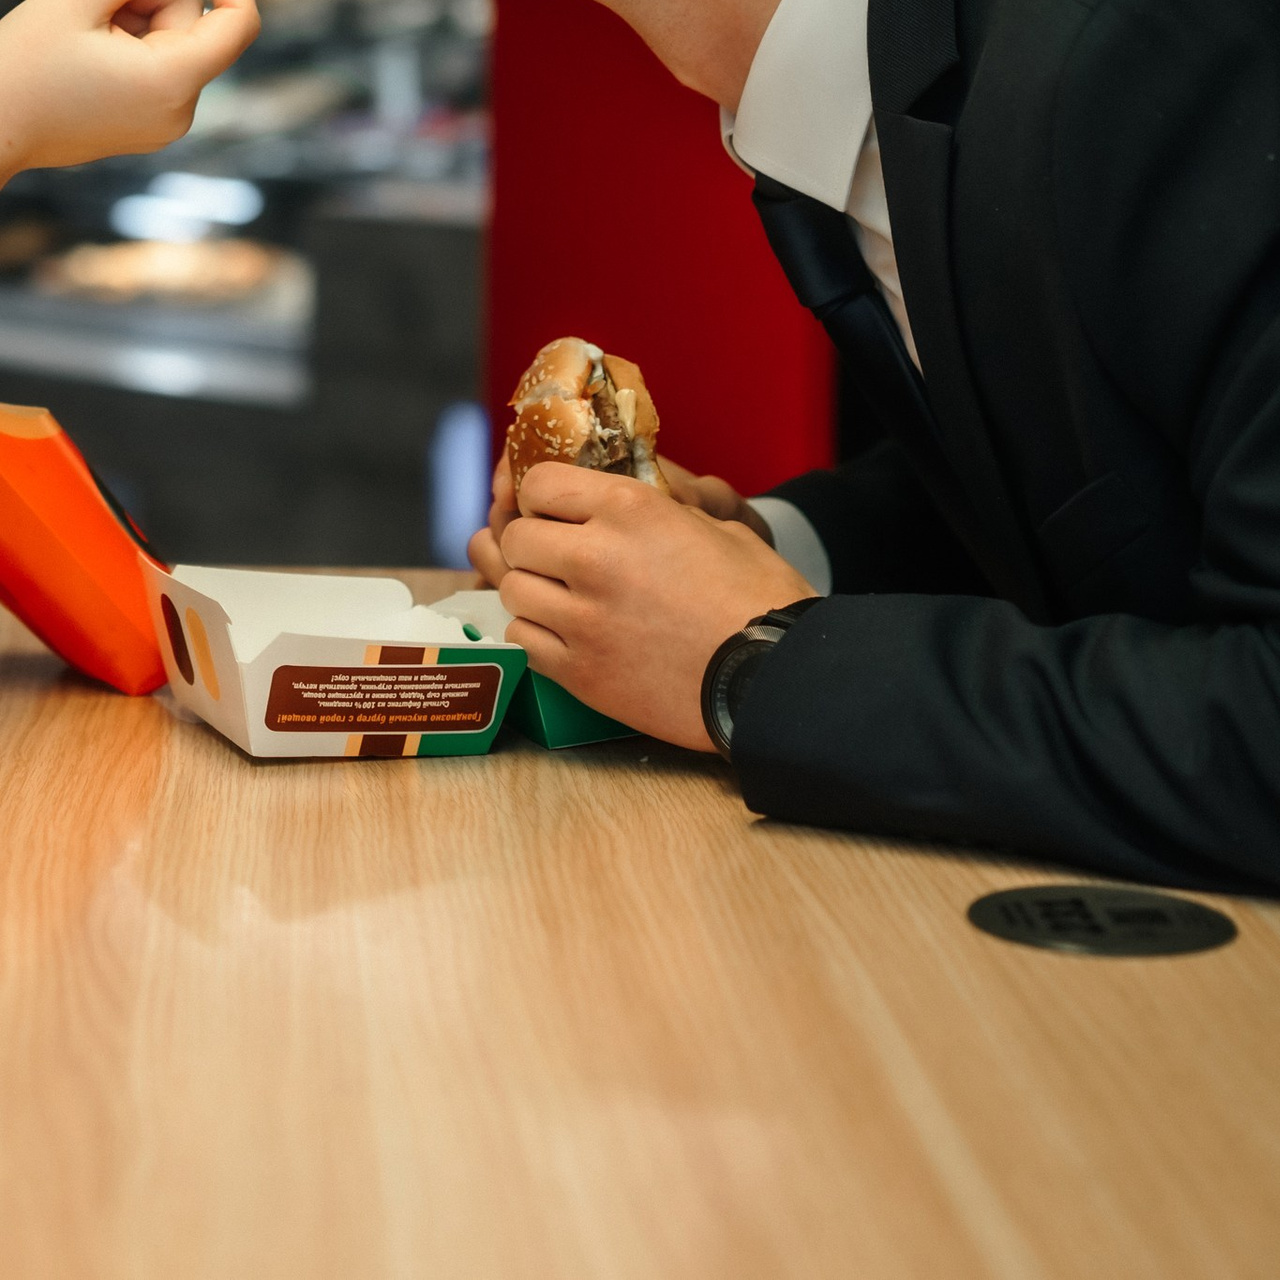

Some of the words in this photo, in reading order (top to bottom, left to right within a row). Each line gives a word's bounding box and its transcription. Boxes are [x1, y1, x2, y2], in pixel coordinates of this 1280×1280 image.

[330, 673, 350, 683] соус!
[351, 674, 397, 683] специальный
[397, 674, 413, 682] наш
[413, 674, 419, 682] и
[419, 673, 447, 681] горчица
[292, 681, 318, 690] кетчуп,
[318, 682, 358, 691] ароматный
[359, 682, 392, 690] огурчики,
[393, 682, 444, 690] маринованные
[444, 682, 481, 690] пикантные
[301, 691, 327, 699] овощи,
[327, 691, 364, 699] хрустящие
[399, 691, 425, 700] Чеддер,
[426, 690, 440, 698] сыр
[441, 691, 469, 700] нежный
[317, 700, 354, 708] говядины,
[387, 700, 422, 709] бифштекс
[422, 700, 450, 709] Сытный
[277, 713, 317, 724] овощей!
[319, 713, 346, 724] горой
[348, 714, 354, 722] с
[356, 713, 387, 725] бургер
[388, 713, 428, 724] вкусный
[430, 711, 482, 723] Грандиозно
